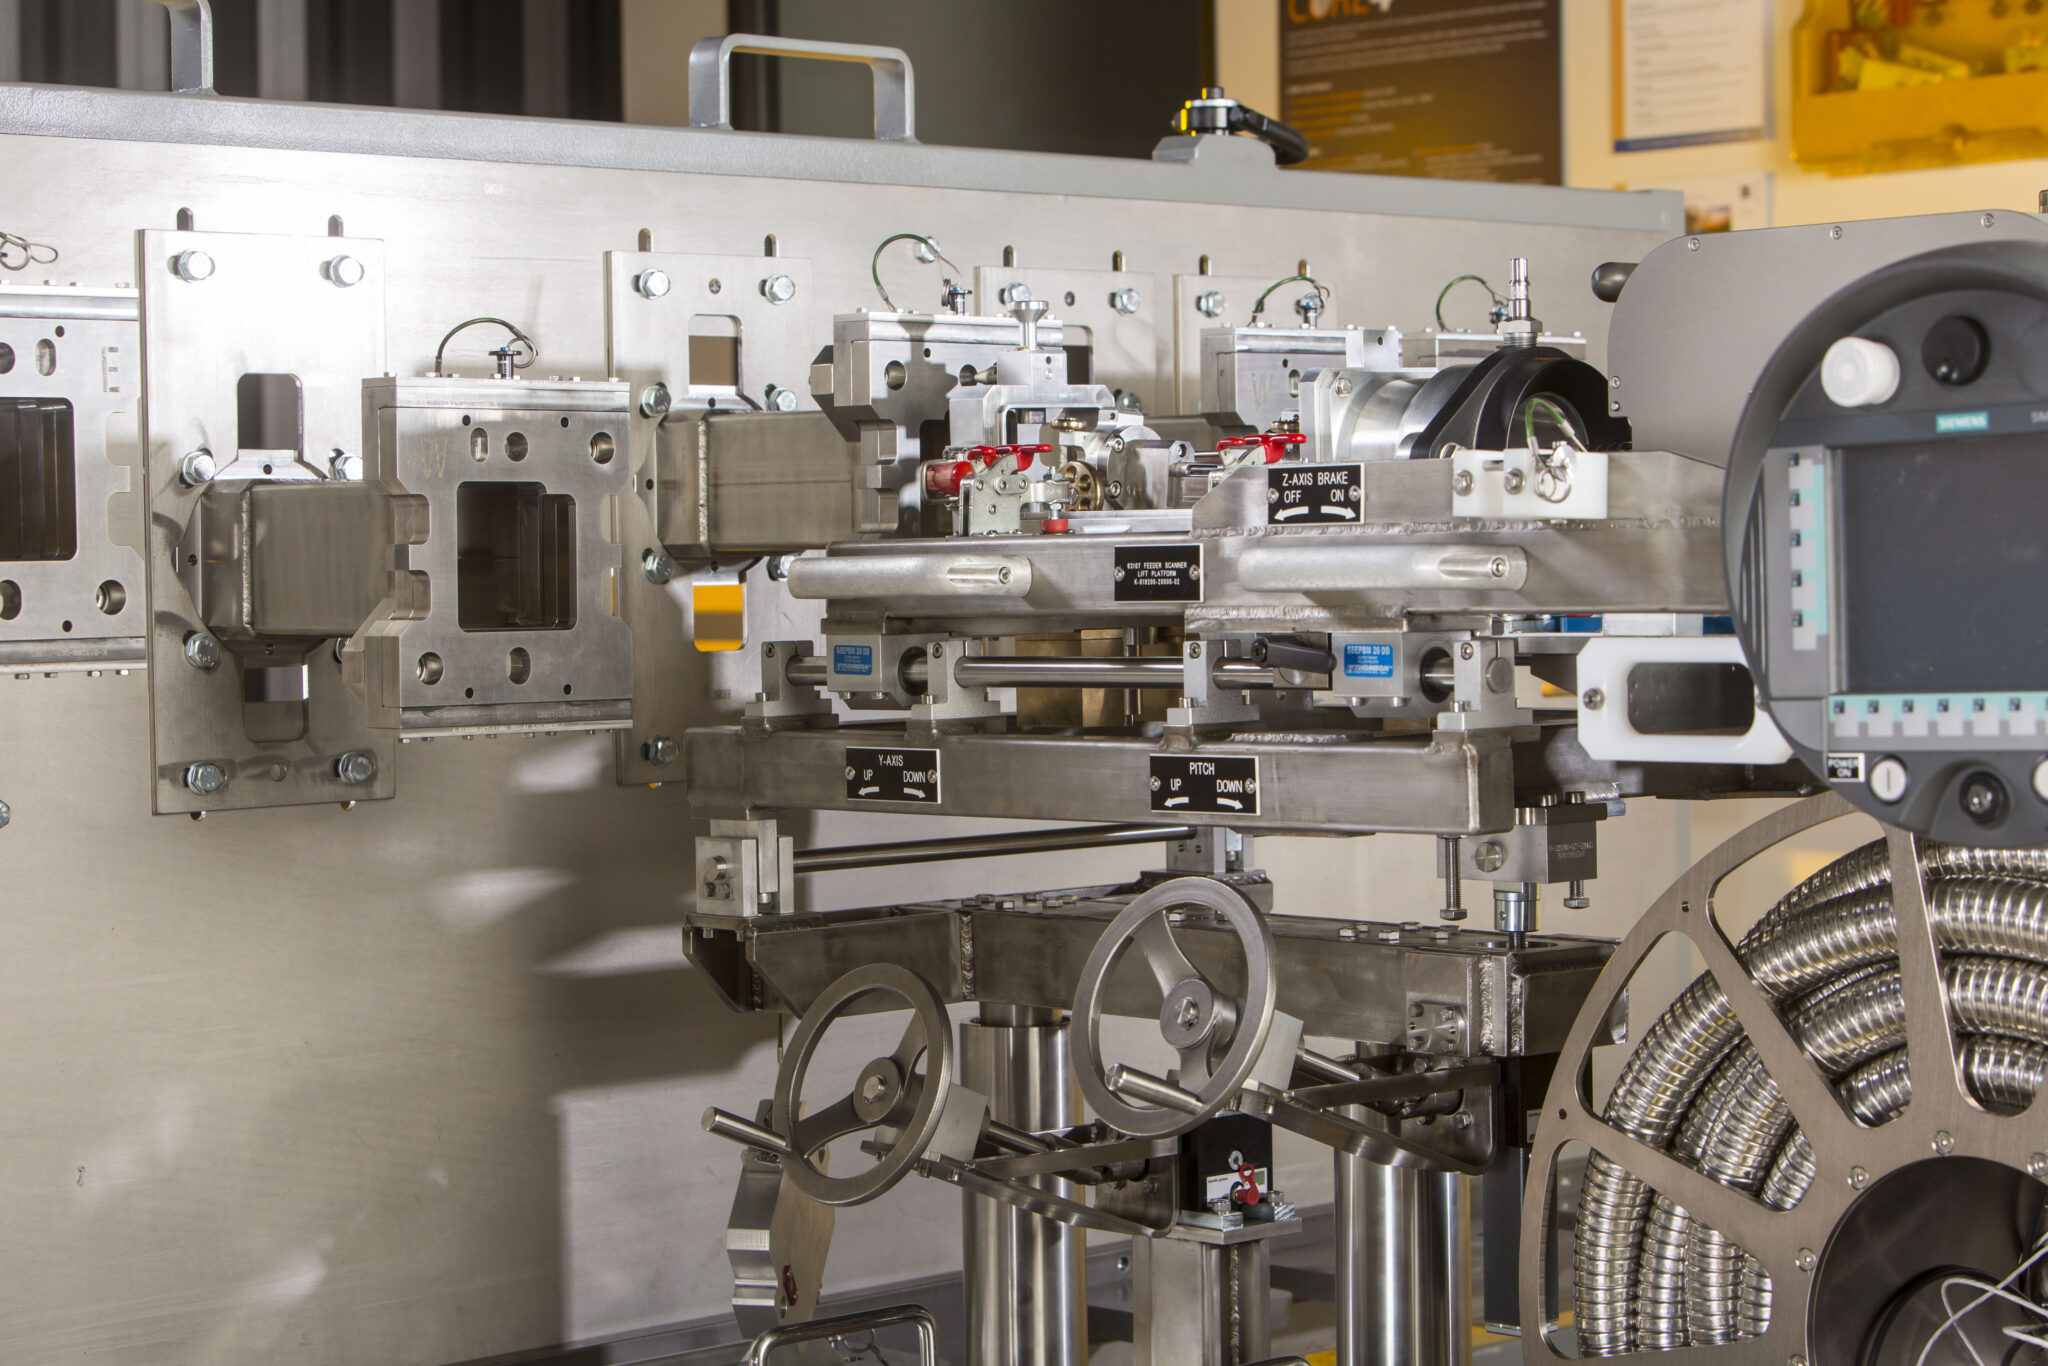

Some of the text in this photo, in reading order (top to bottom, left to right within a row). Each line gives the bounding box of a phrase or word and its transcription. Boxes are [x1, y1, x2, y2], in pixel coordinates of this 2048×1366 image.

[1939, 415, 1987, 430] SIEMENS
[1282, 471, 1348, 486] Z-AXIS BRAKE
[1284, 490, 1302, 503] OFF
[1330, 489, 1345, 502] ON
[1144, 562, 1162, 570] FEEDER
[879, 754, 904, 767] Y-AXIS
[1190, 762, 1215, 775] PITCH
[1836, 768, 1852, 778] ON
[864, 769, 926, 783] UP DOWN
[1170, 778, 1243, 793] UP DOWN
